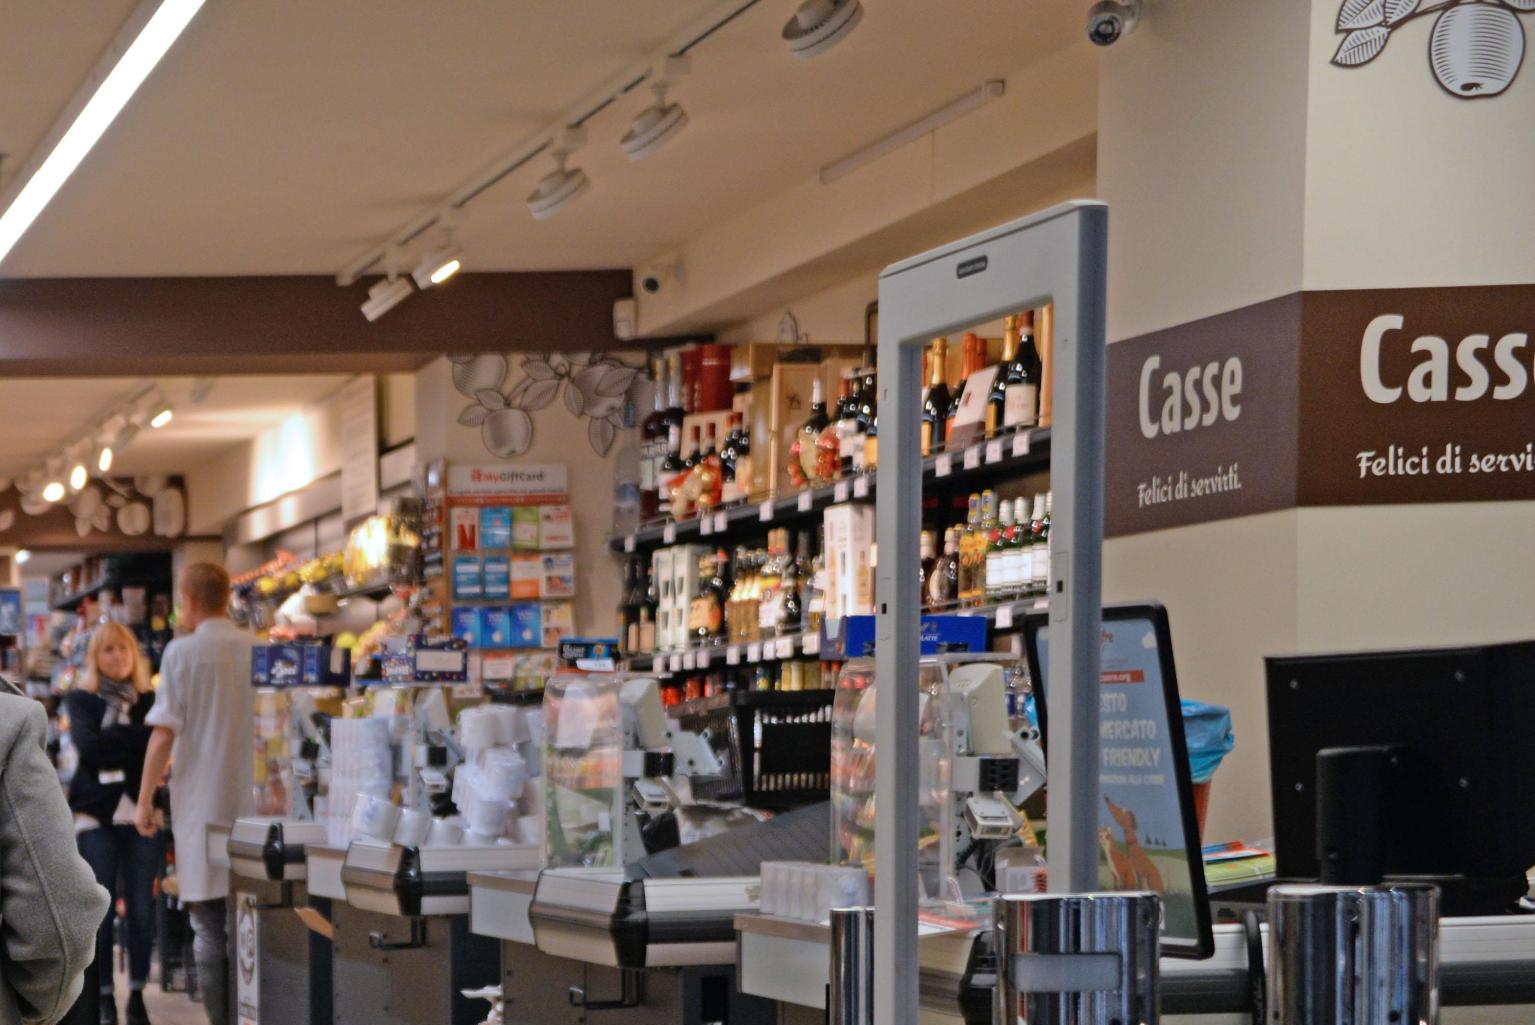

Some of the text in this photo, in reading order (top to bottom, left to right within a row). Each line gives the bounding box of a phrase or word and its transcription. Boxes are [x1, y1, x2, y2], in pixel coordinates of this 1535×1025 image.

[1360, 313, 1535, 404] Cass
[1139, 354, 1243, 439] Casse
[1356, 442, 1535, 478] Felici di servi
[1137, 462, 1242, 509] Felici di servirti.
[1103, 747, 1161, 768] FRIENDLY
